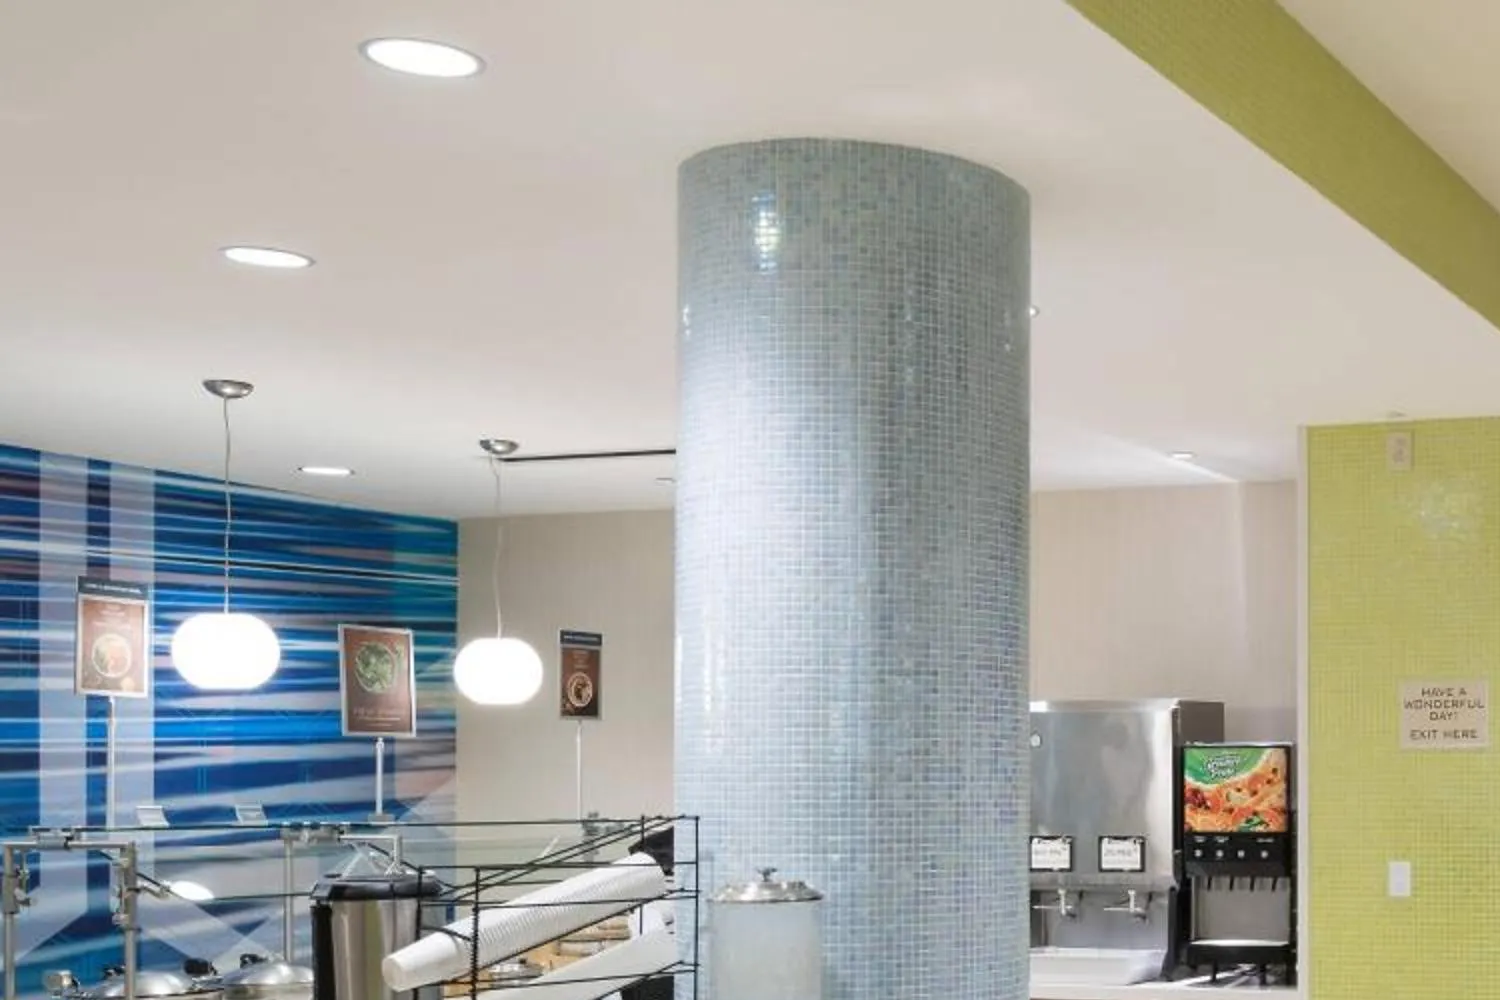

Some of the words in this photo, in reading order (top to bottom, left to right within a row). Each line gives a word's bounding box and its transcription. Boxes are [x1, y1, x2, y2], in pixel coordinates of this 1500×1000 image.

[1421, 687, 1455, 697] HAVE
[1459, 687, 1467, 696] A
[1404, 699, 1486, 709] WONDERFUL
[1410, 729, 1438, 740] EXIT
[1443, 729, 1479, 739] HERE
